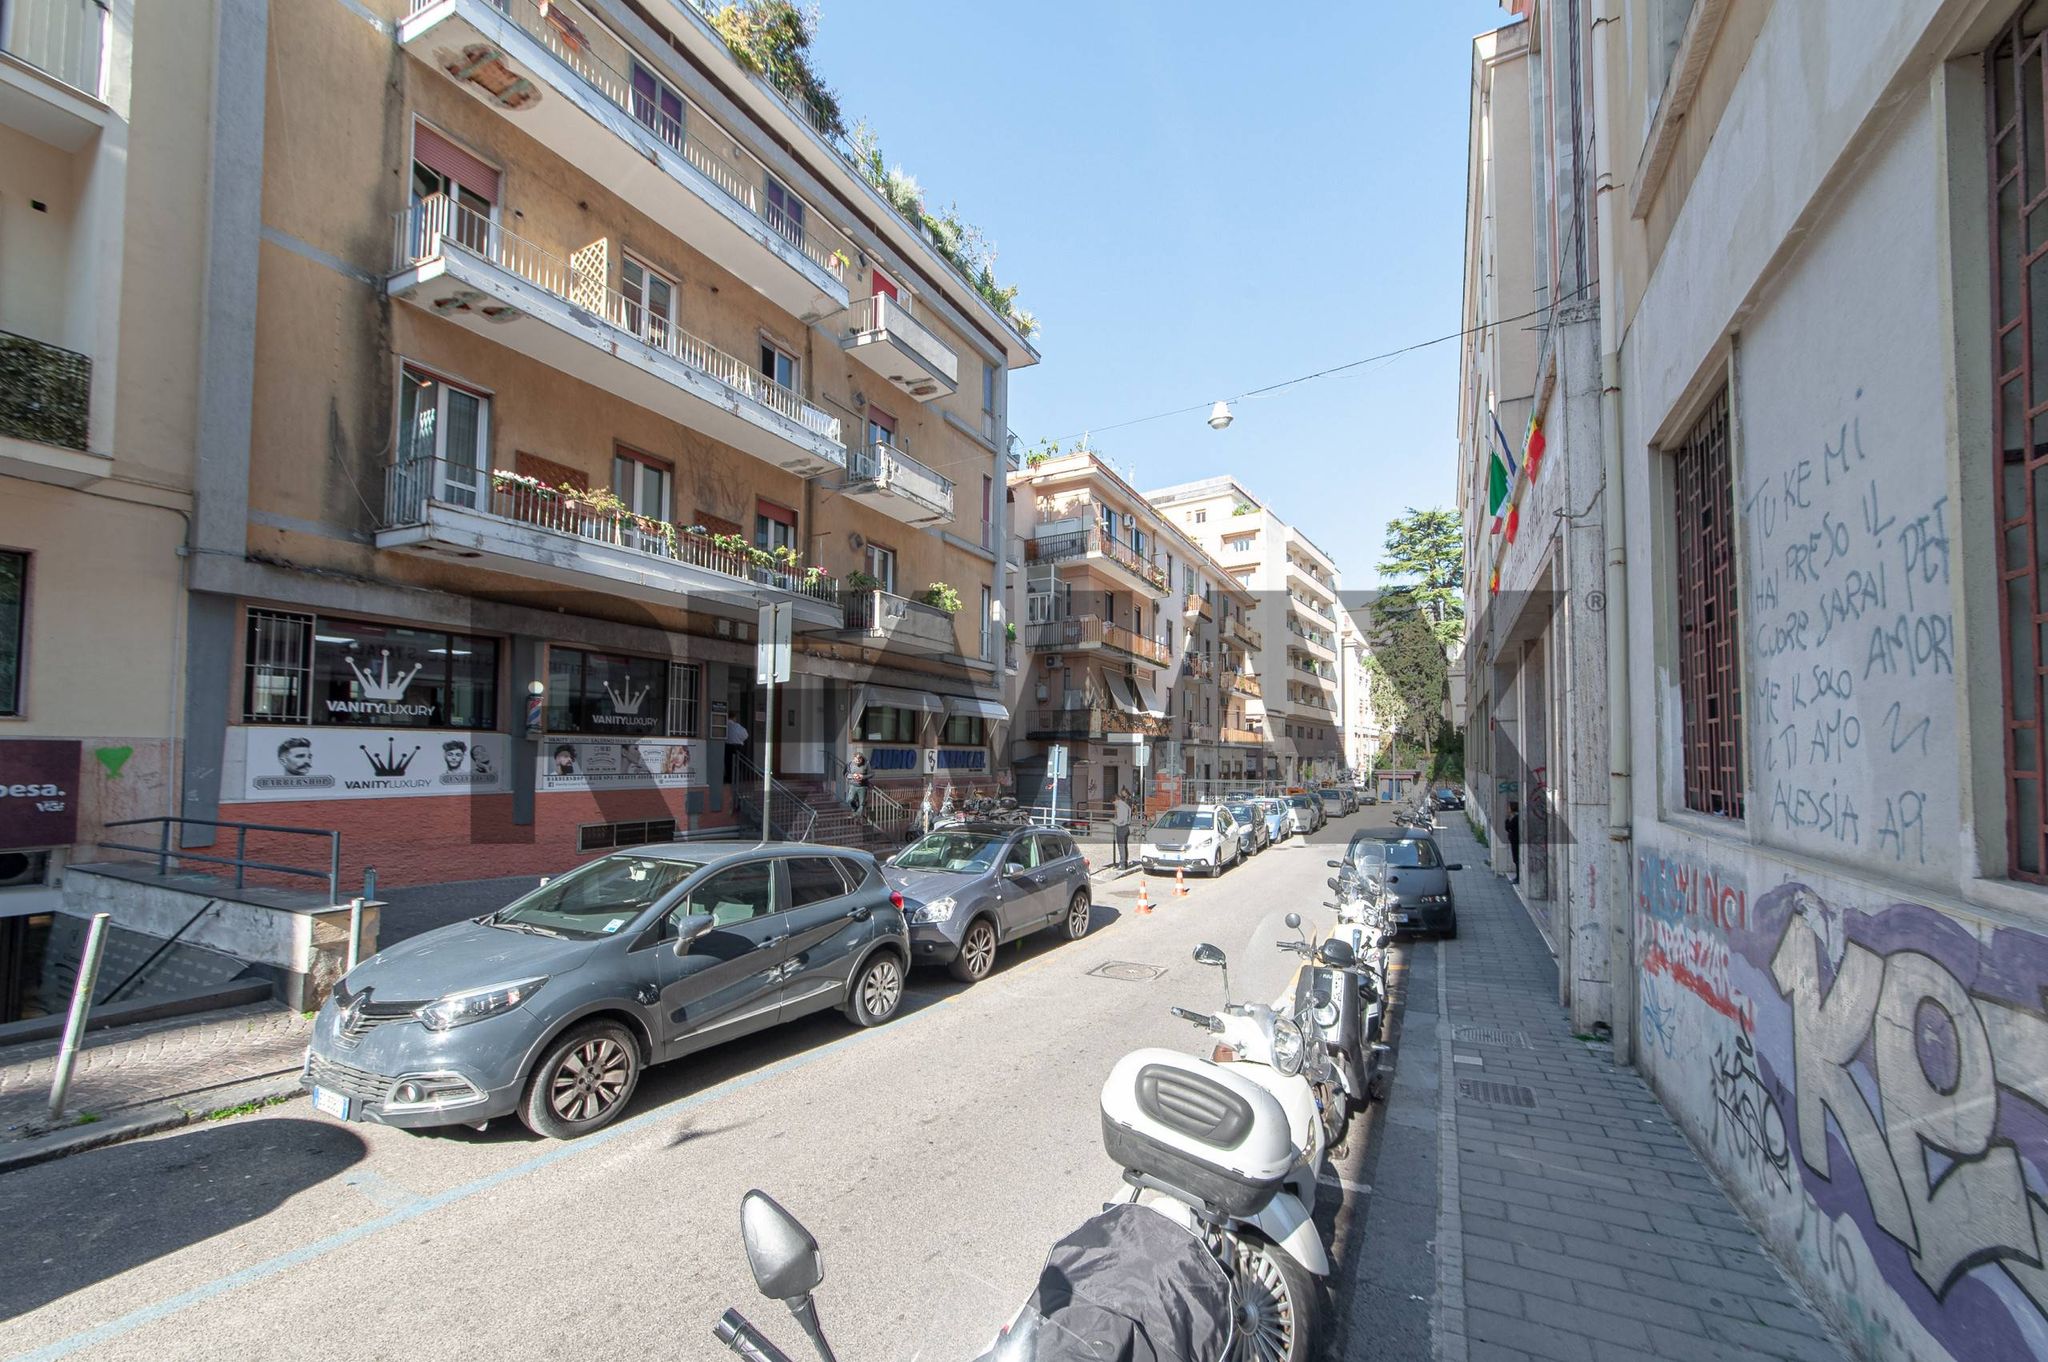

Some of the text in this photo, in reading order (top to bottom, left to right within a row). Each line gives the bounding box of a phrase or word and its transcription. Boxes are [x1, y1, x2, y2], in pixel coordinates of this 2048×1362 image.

[1746, 387, 1866, 570] TU KE MI
[1755, 479, 1896, 614] HAI PRESO IL
[1816, 540, 1887, 648] SARAI
[326, 700, 435, 717] VANITYLUXURY
[1810, 664, 1853, 704] SOLO
[1809, 708, 1861, 765] AMO
[345, 779, 432, 789] VANITYLUXURY
[1770, 777, 1859, 846] ALESSIA
